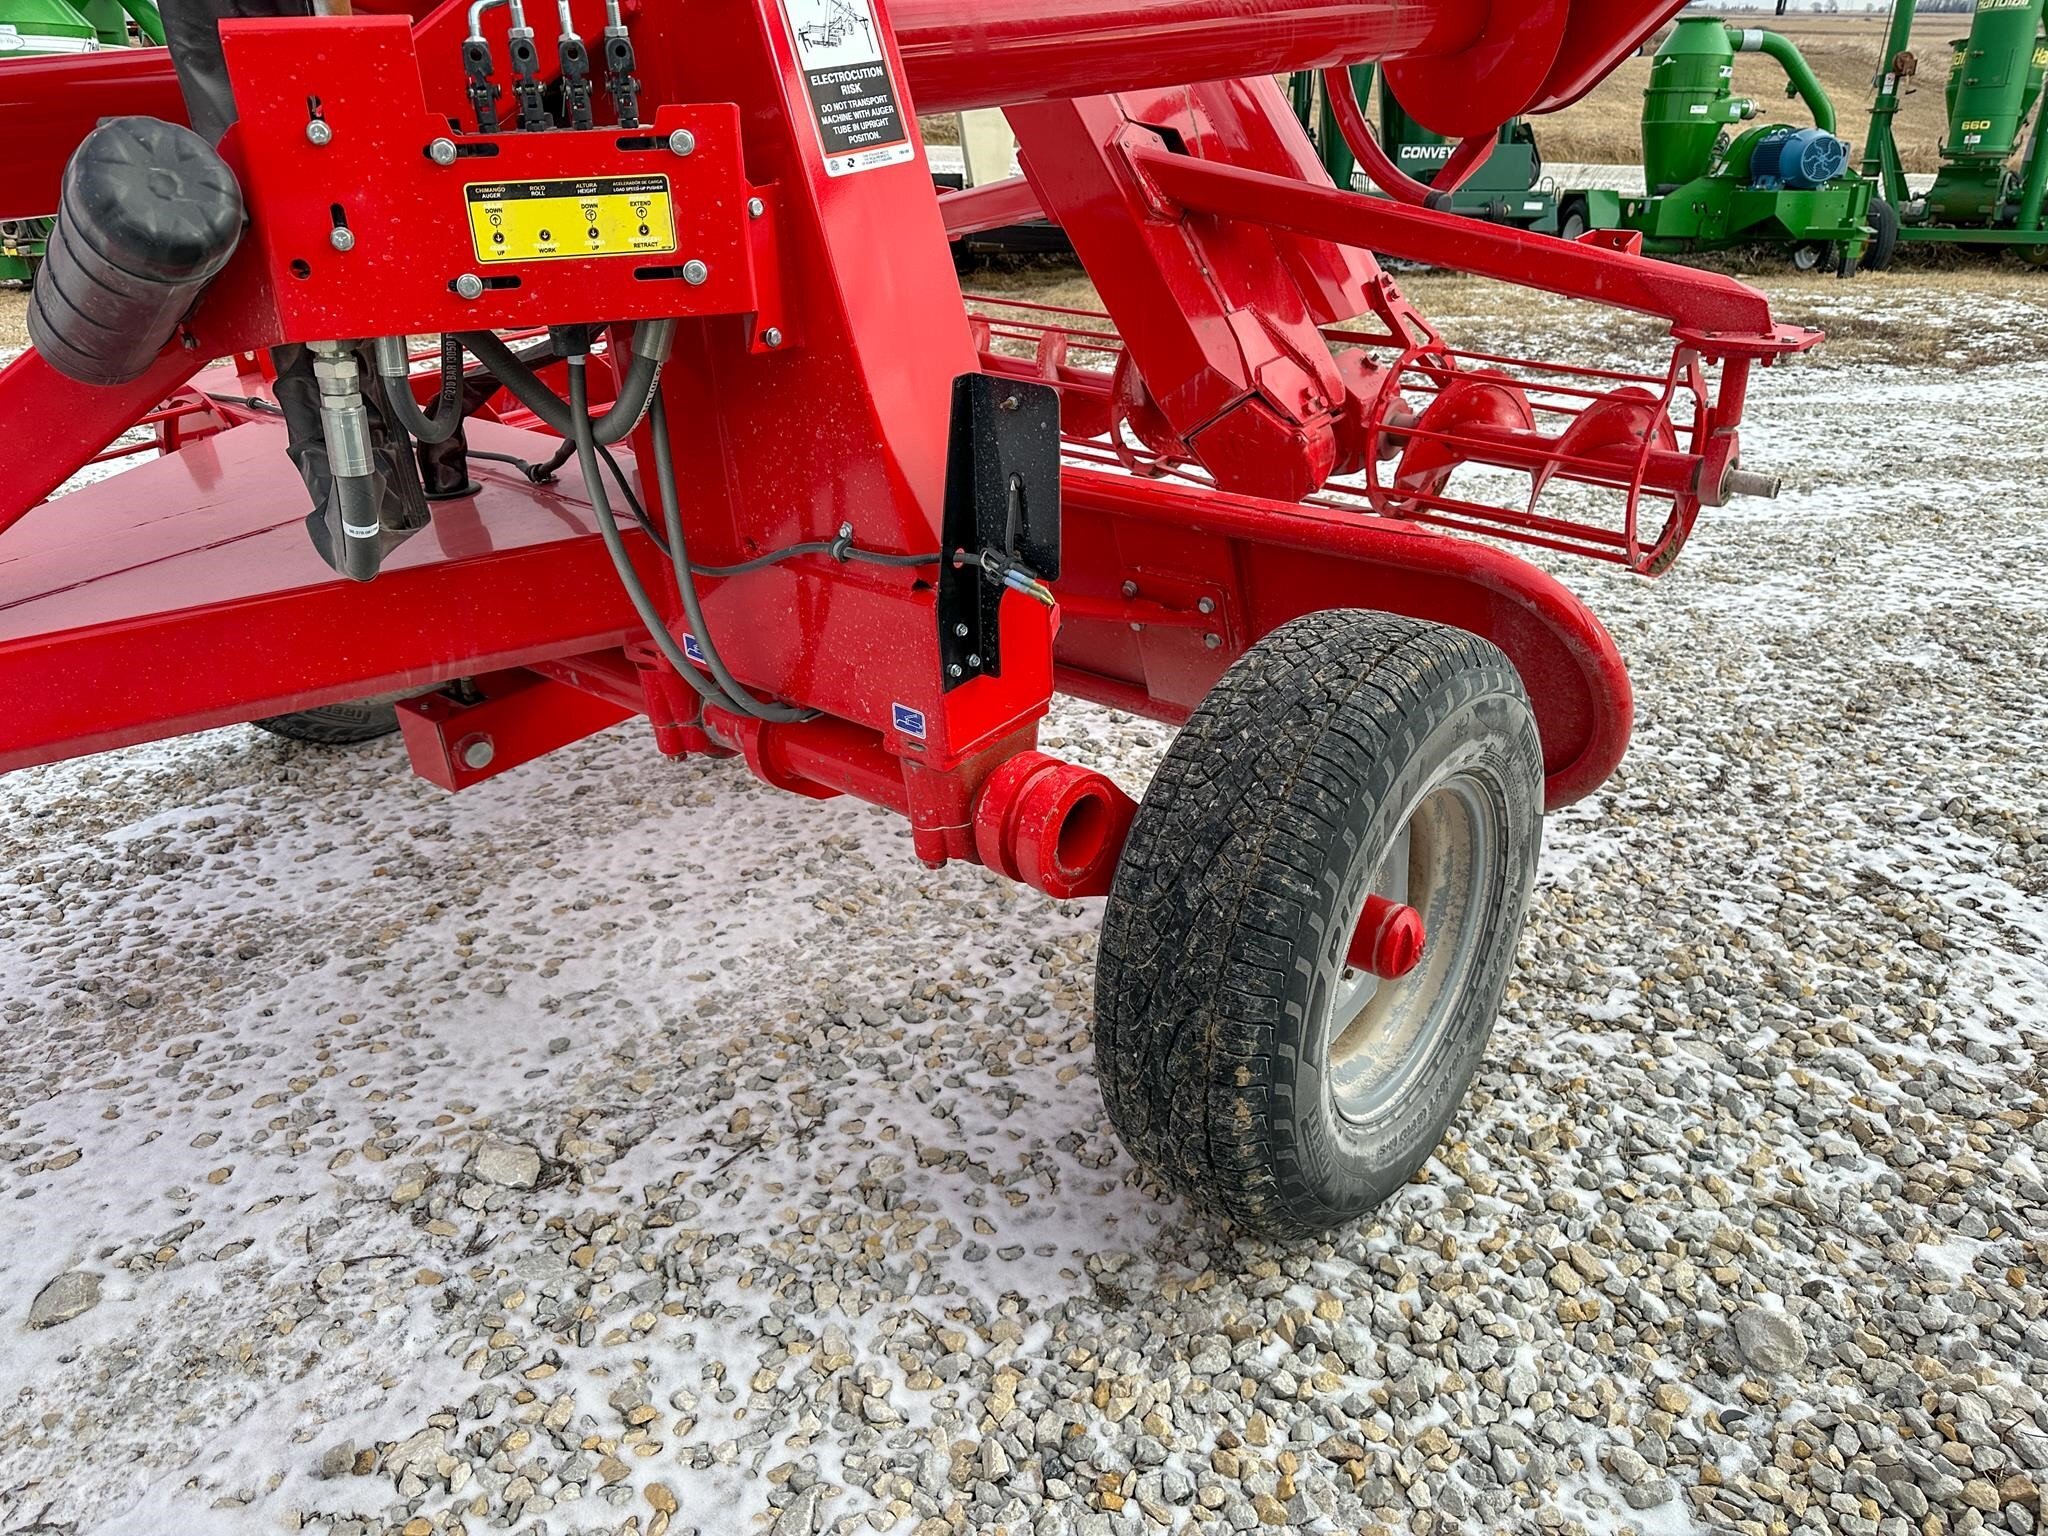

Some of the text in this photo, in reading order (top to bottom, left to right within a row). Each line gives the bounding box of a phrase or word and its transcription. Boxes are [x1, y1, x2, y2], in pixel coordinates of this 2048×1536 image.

[810, 66, 883, 85] ELECTROCUTION
[840, 82, 863, 96] RISK
[821, 94, 888, 113] DO NOT TRANSPORT
[821, 105, 894, 125] MACHINE WITH AUGER
[832, 117, 889, 135] TUBE IN UPRIGHT
[1961, 120, 1991, 130] 660
[848, 131, 881, 144] POSITION.
